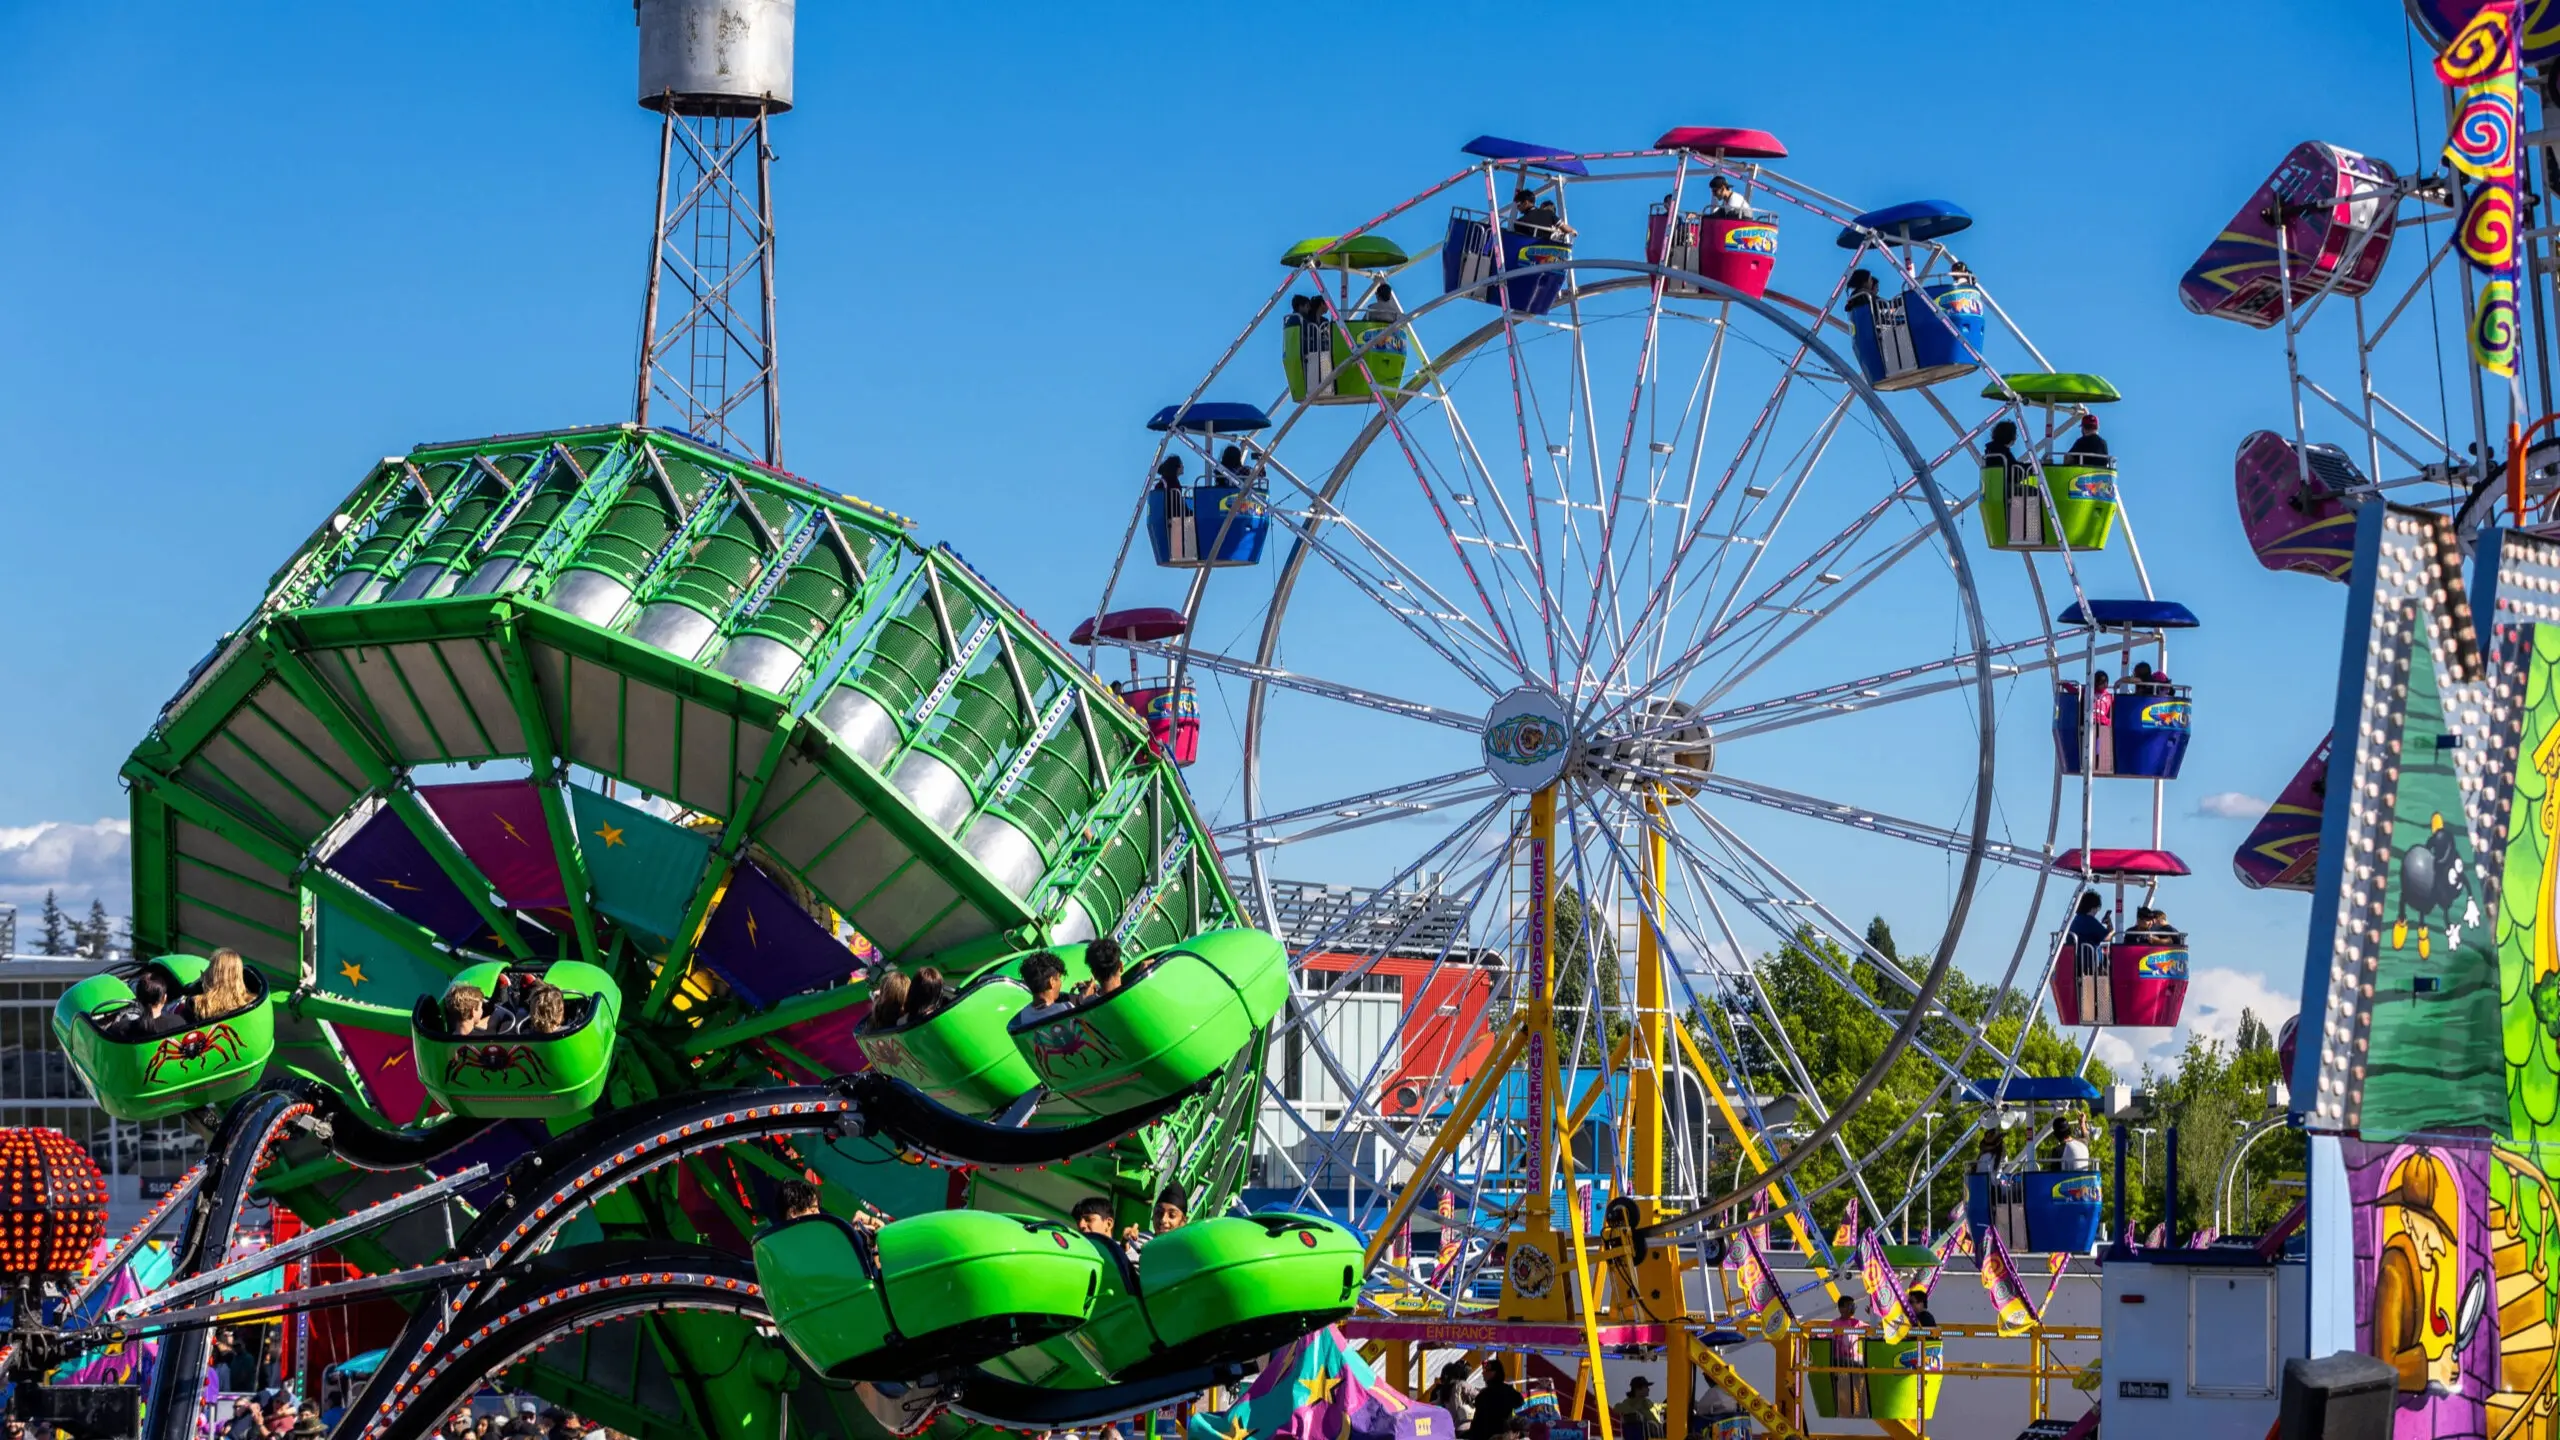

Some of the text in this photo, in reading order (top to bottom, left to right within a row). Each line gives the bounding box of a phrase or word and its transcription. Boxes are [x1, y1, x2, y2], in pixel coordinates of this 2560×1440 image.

[1490, 721, 1563, 757] WCA
[1532, 839, 1545, 999] WESTCOAST
[1426, 1325, 1497, 1340] ENTRANCE
